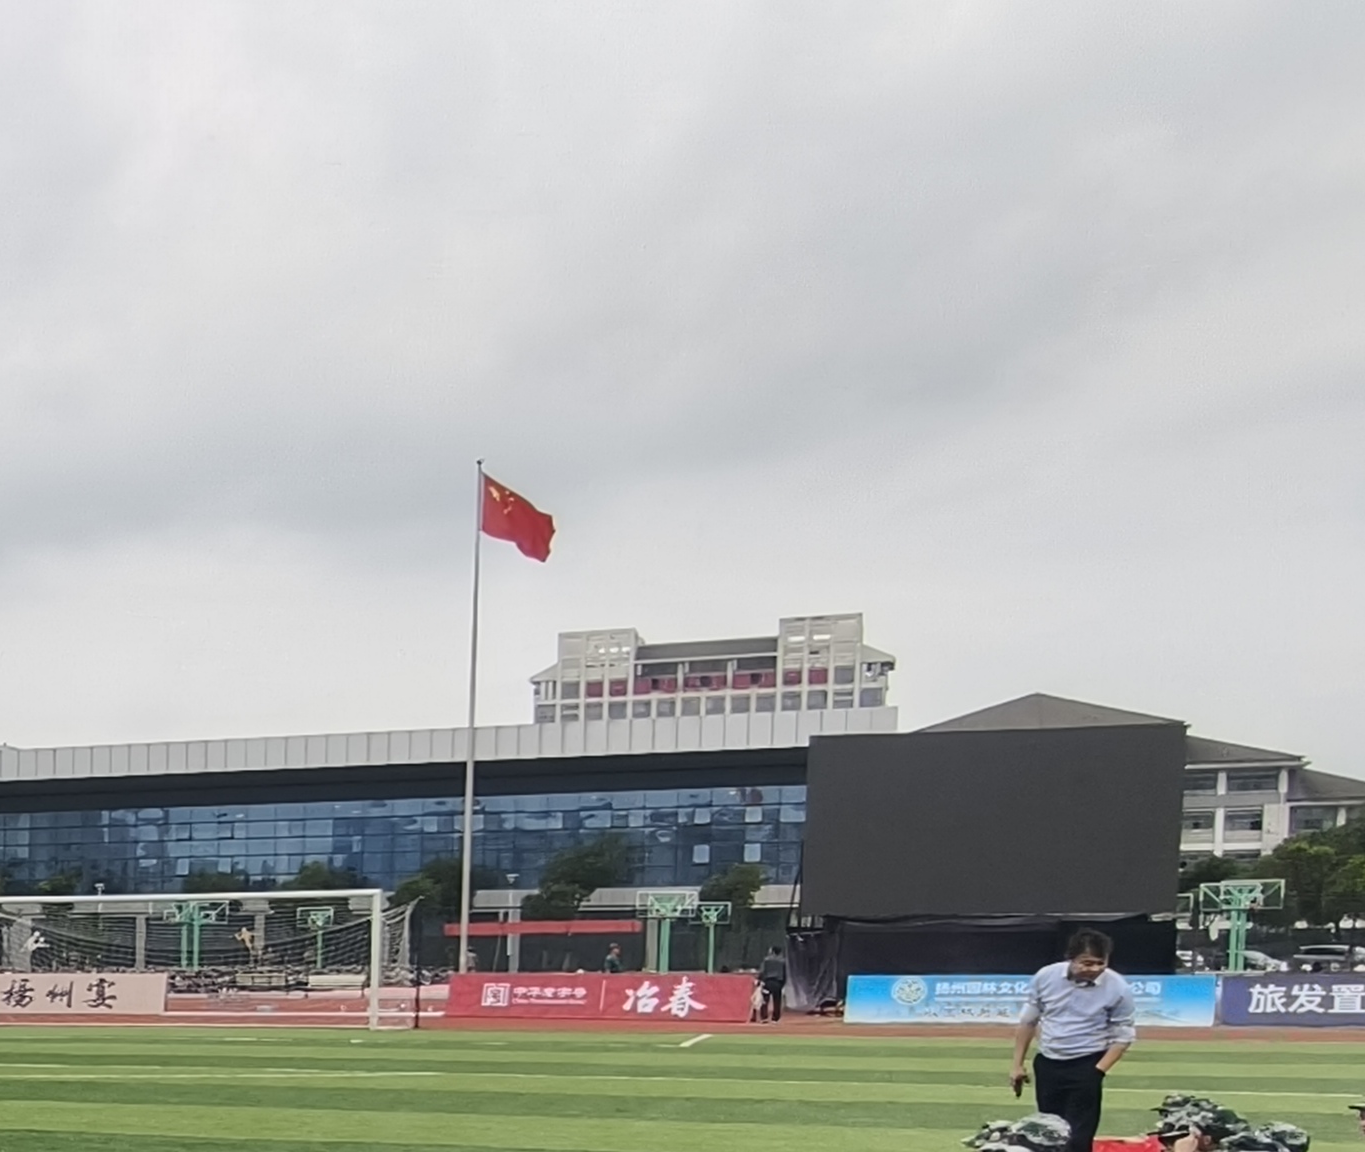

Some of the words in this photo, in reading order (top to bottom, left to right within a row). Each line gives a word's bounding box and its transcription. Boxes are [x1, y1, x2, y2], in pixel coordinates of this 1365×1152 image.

[622, 976, 707, 1017] 冶春
[1248, 983, 1365, 1013] 旅发置
